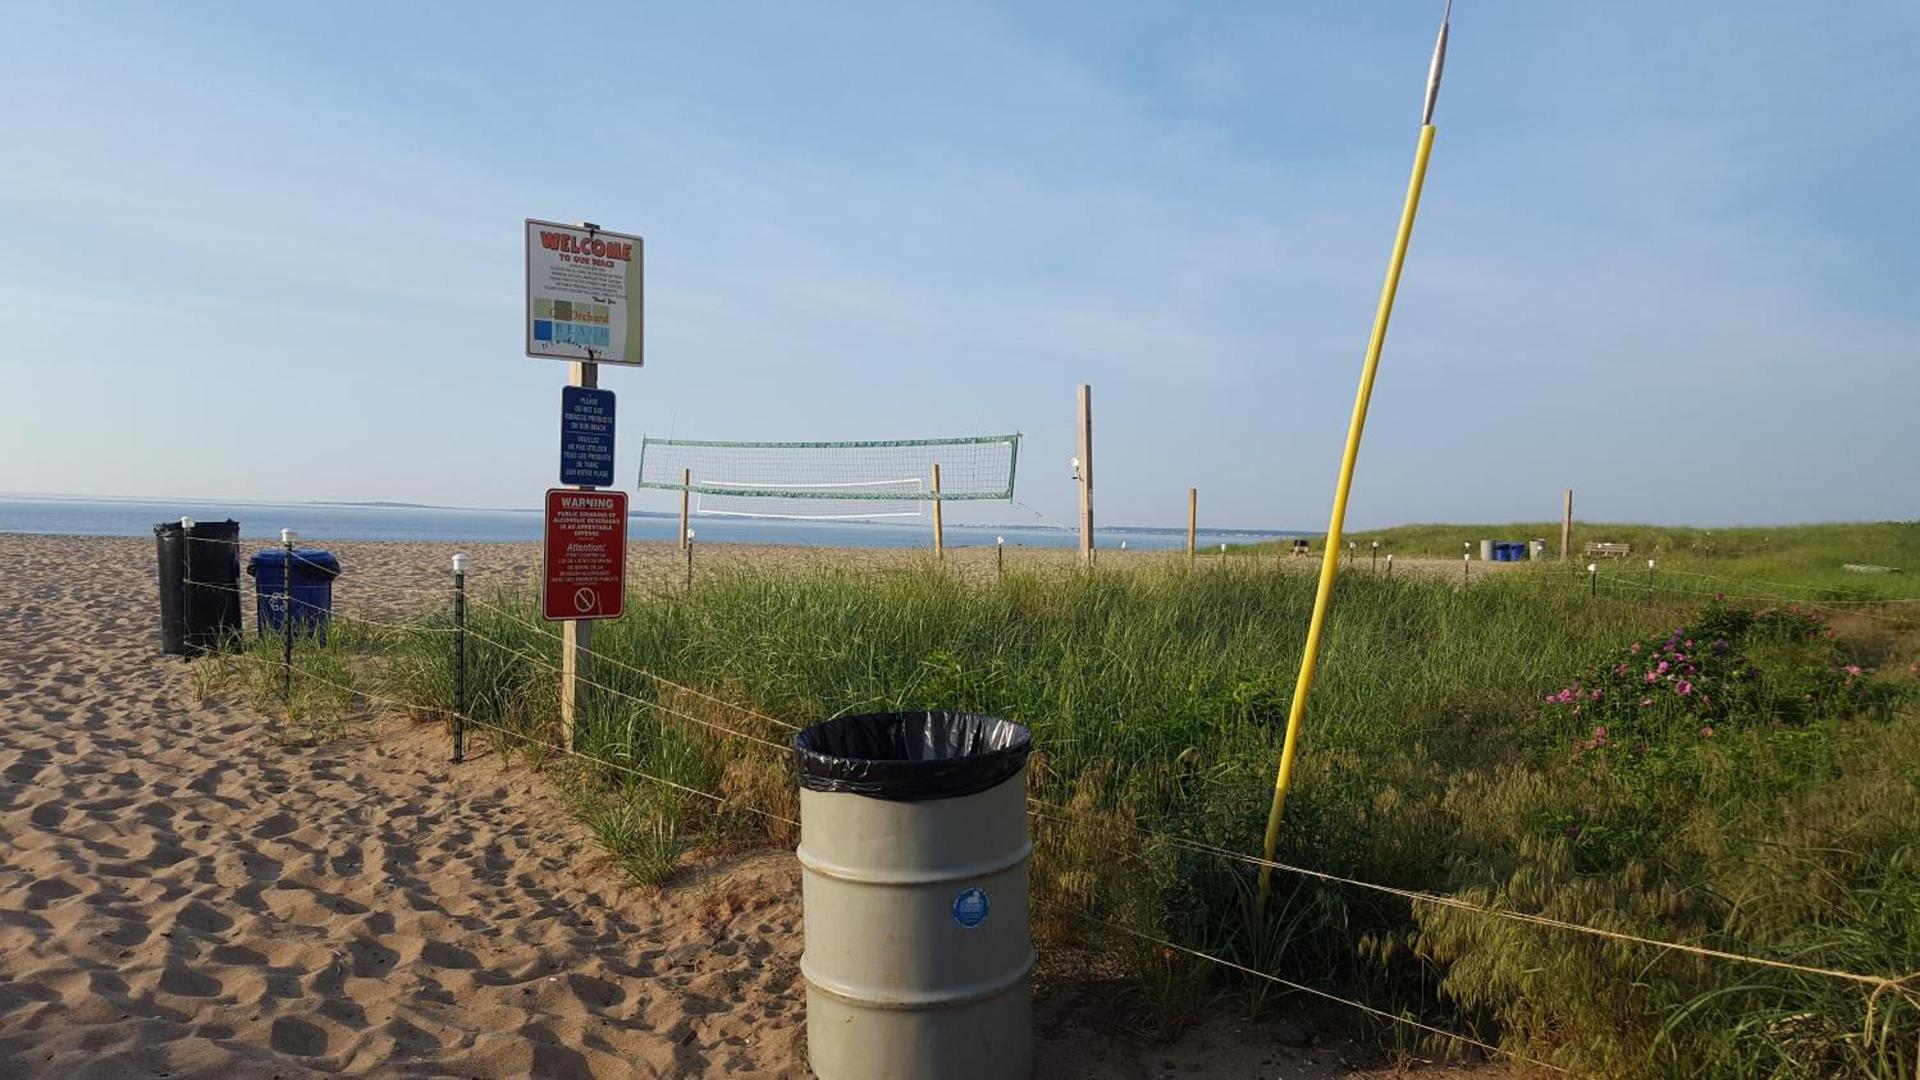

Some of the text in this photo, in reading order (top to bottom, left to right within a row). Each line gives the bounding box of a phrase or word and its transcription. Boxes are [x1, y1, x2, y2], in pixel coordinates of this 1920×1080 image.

[540, 231, 632, 262] WELCOME
[559, 253, 571, 262] TO
[573, 255, 590, 265] OUR
[580, 397, 599, 405] PLEASE
[583, 406, 592, 414] NOT
[561, 498, 614, 508] WARNING
